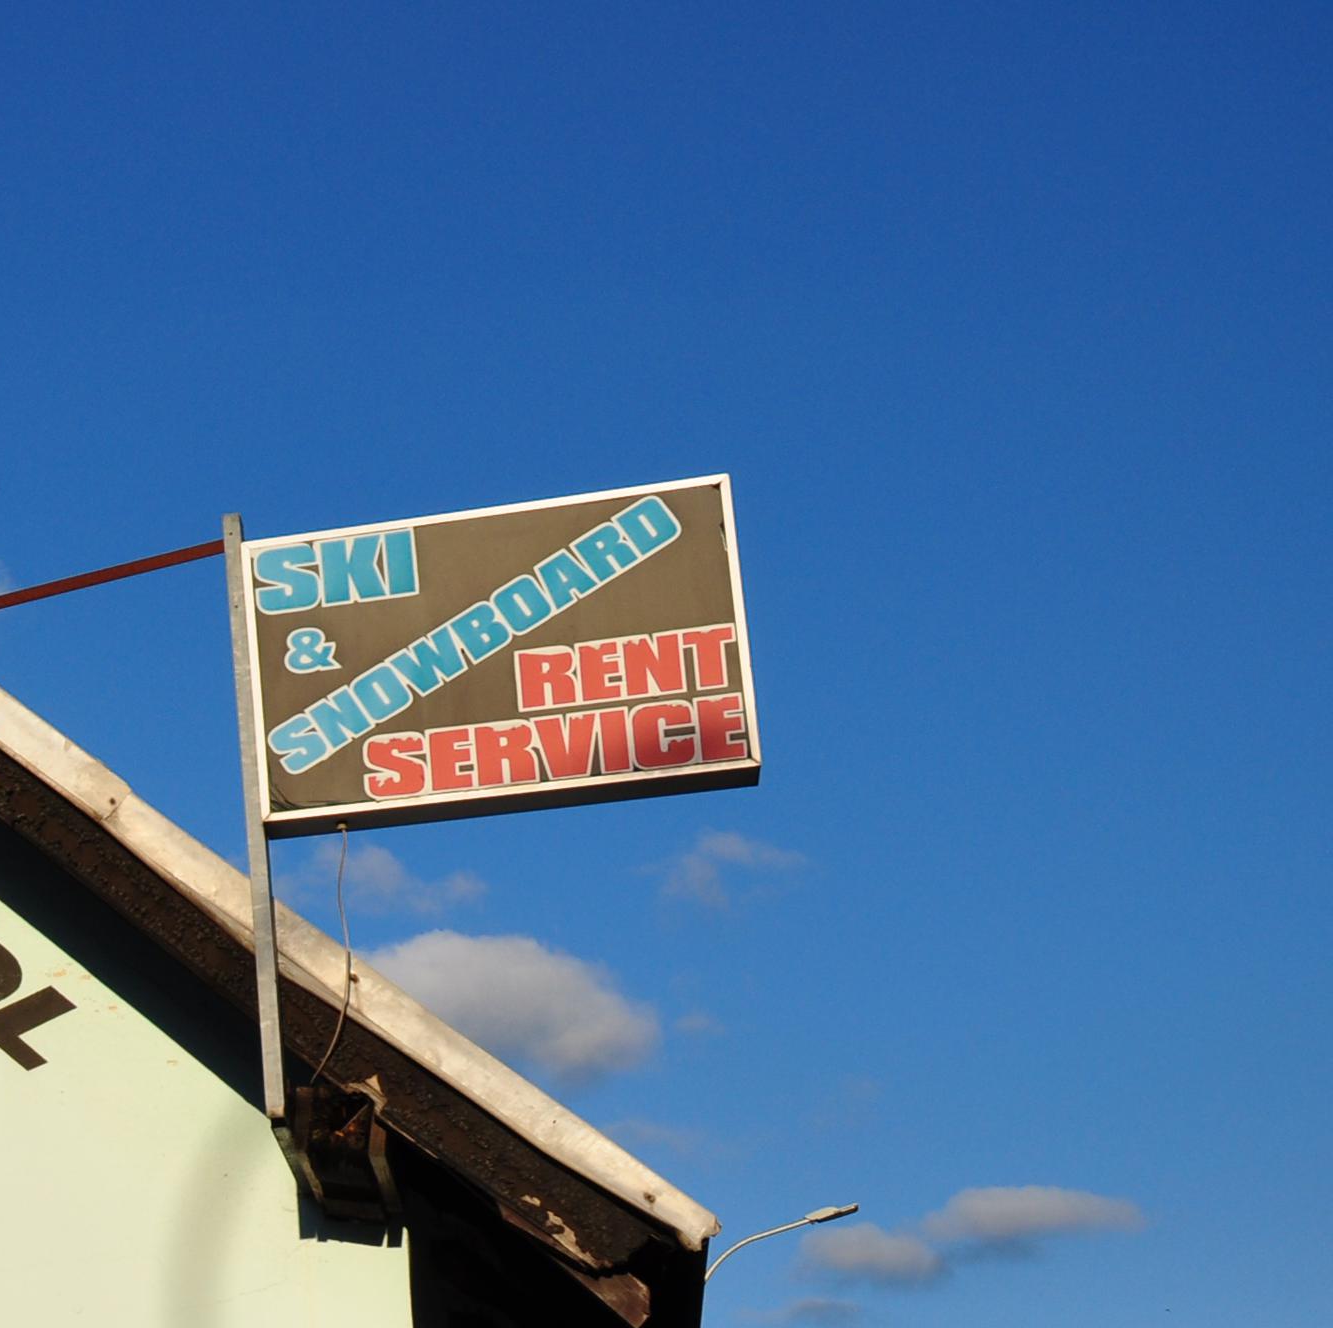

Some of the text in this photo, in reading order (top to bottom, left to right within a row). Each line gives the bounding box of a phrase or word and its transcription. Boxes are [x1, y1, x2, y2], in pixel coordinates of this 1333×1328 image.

[254, 527, 420, 615] SKI
[268, 495, 682, 775] SNOWBOARD
[286, 627, 343, 675] &
[514, 623, 737, 712] RENT
[363, 694, 748, 800] SERVICE
